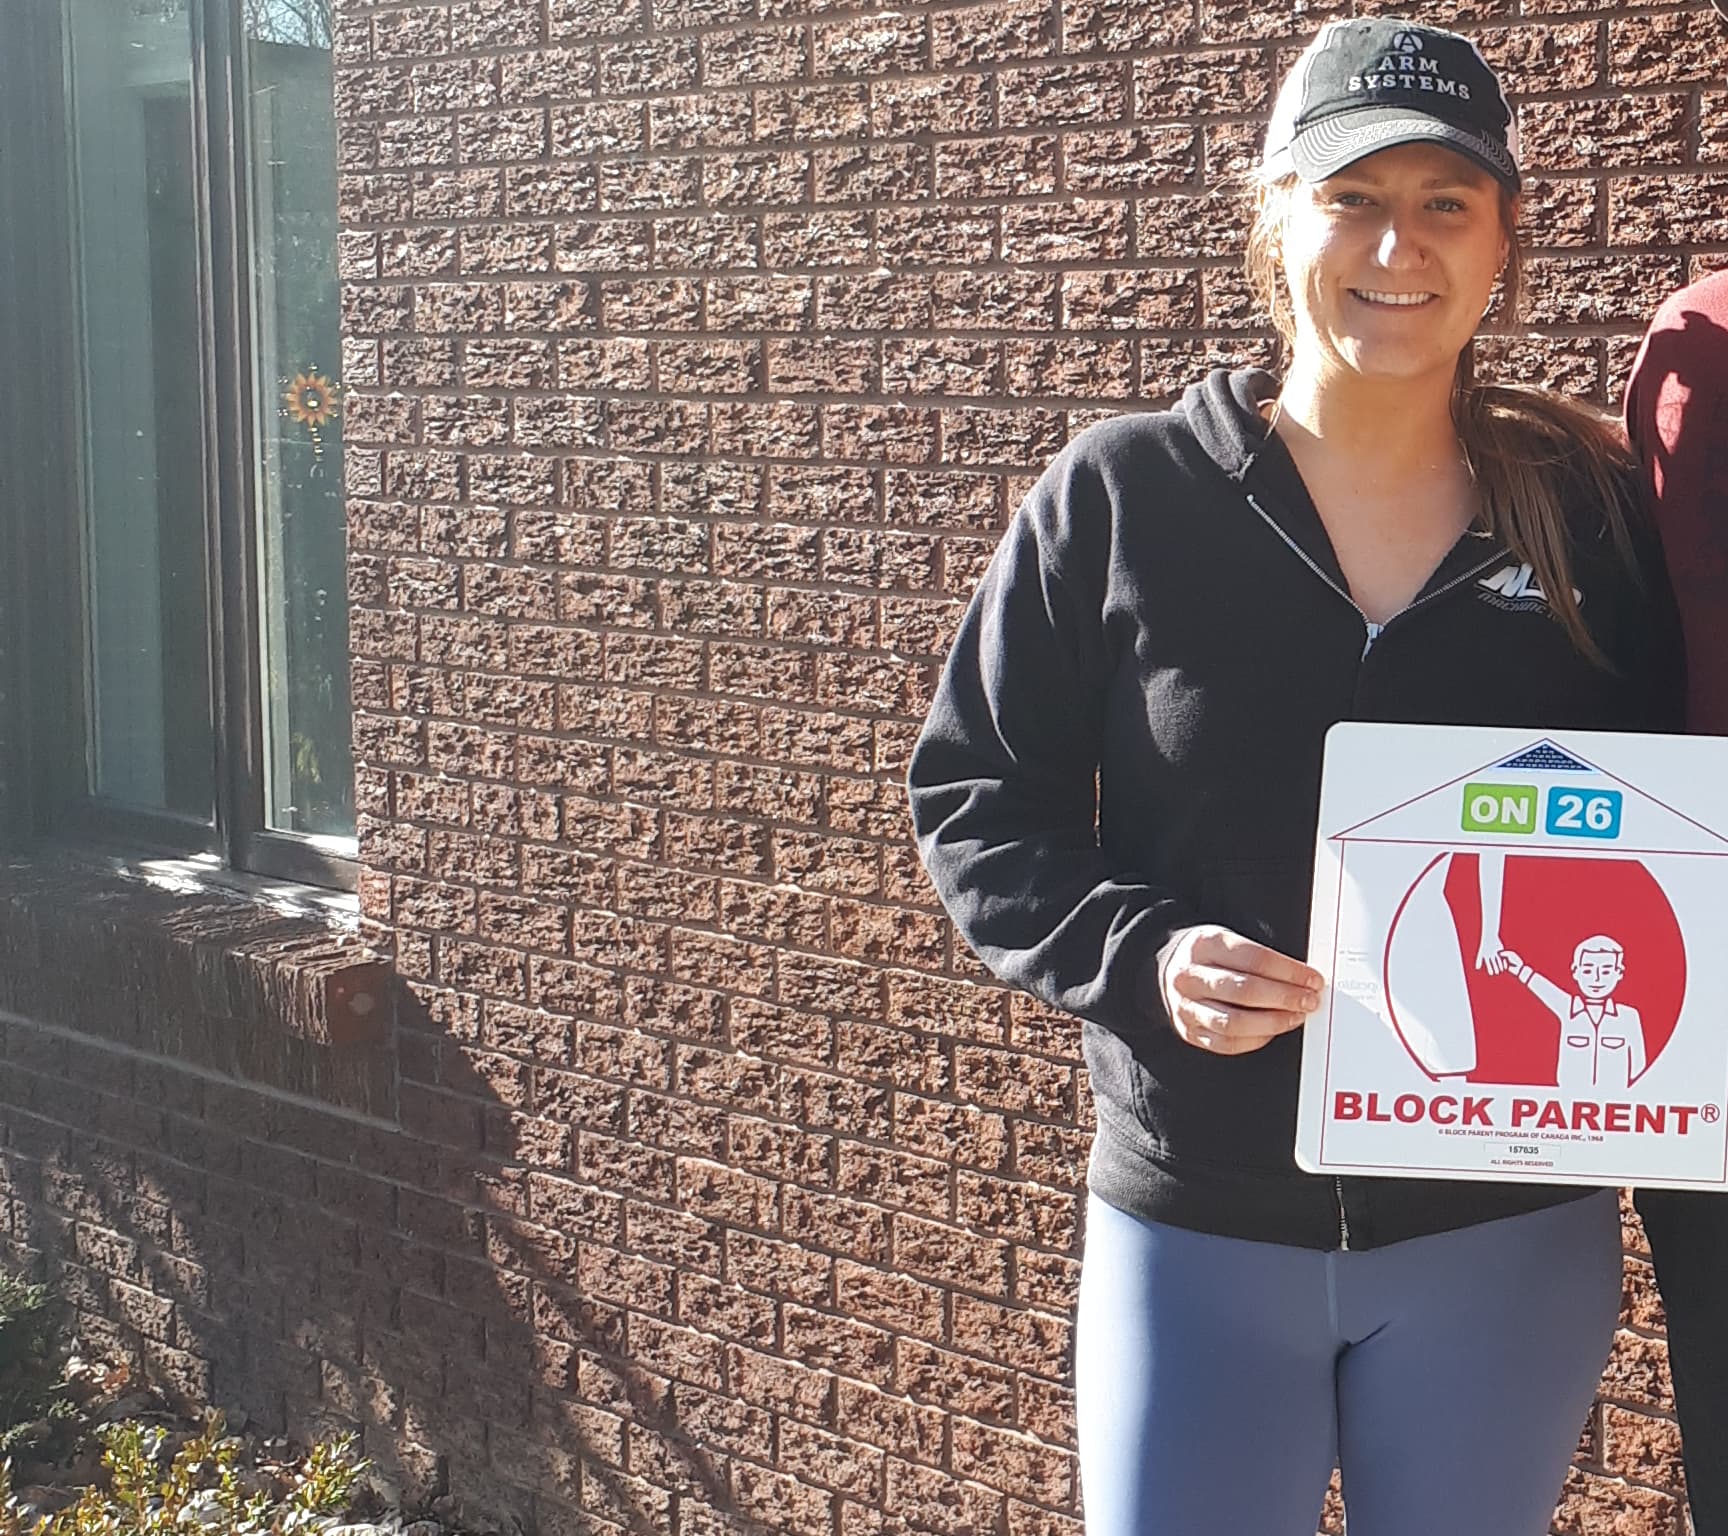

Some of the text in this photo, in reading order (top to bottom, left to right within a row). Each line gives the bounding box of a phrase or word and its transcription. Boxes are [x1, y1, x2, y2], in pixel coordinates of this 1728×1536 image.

[1379, 56, 1439, 75] ARM
[1348, 75, 1470, 100] SYSTEMS
[1470, 794, 1613, 831] ON 26
[1334, 1091, 1494, 1126] BLOCK
